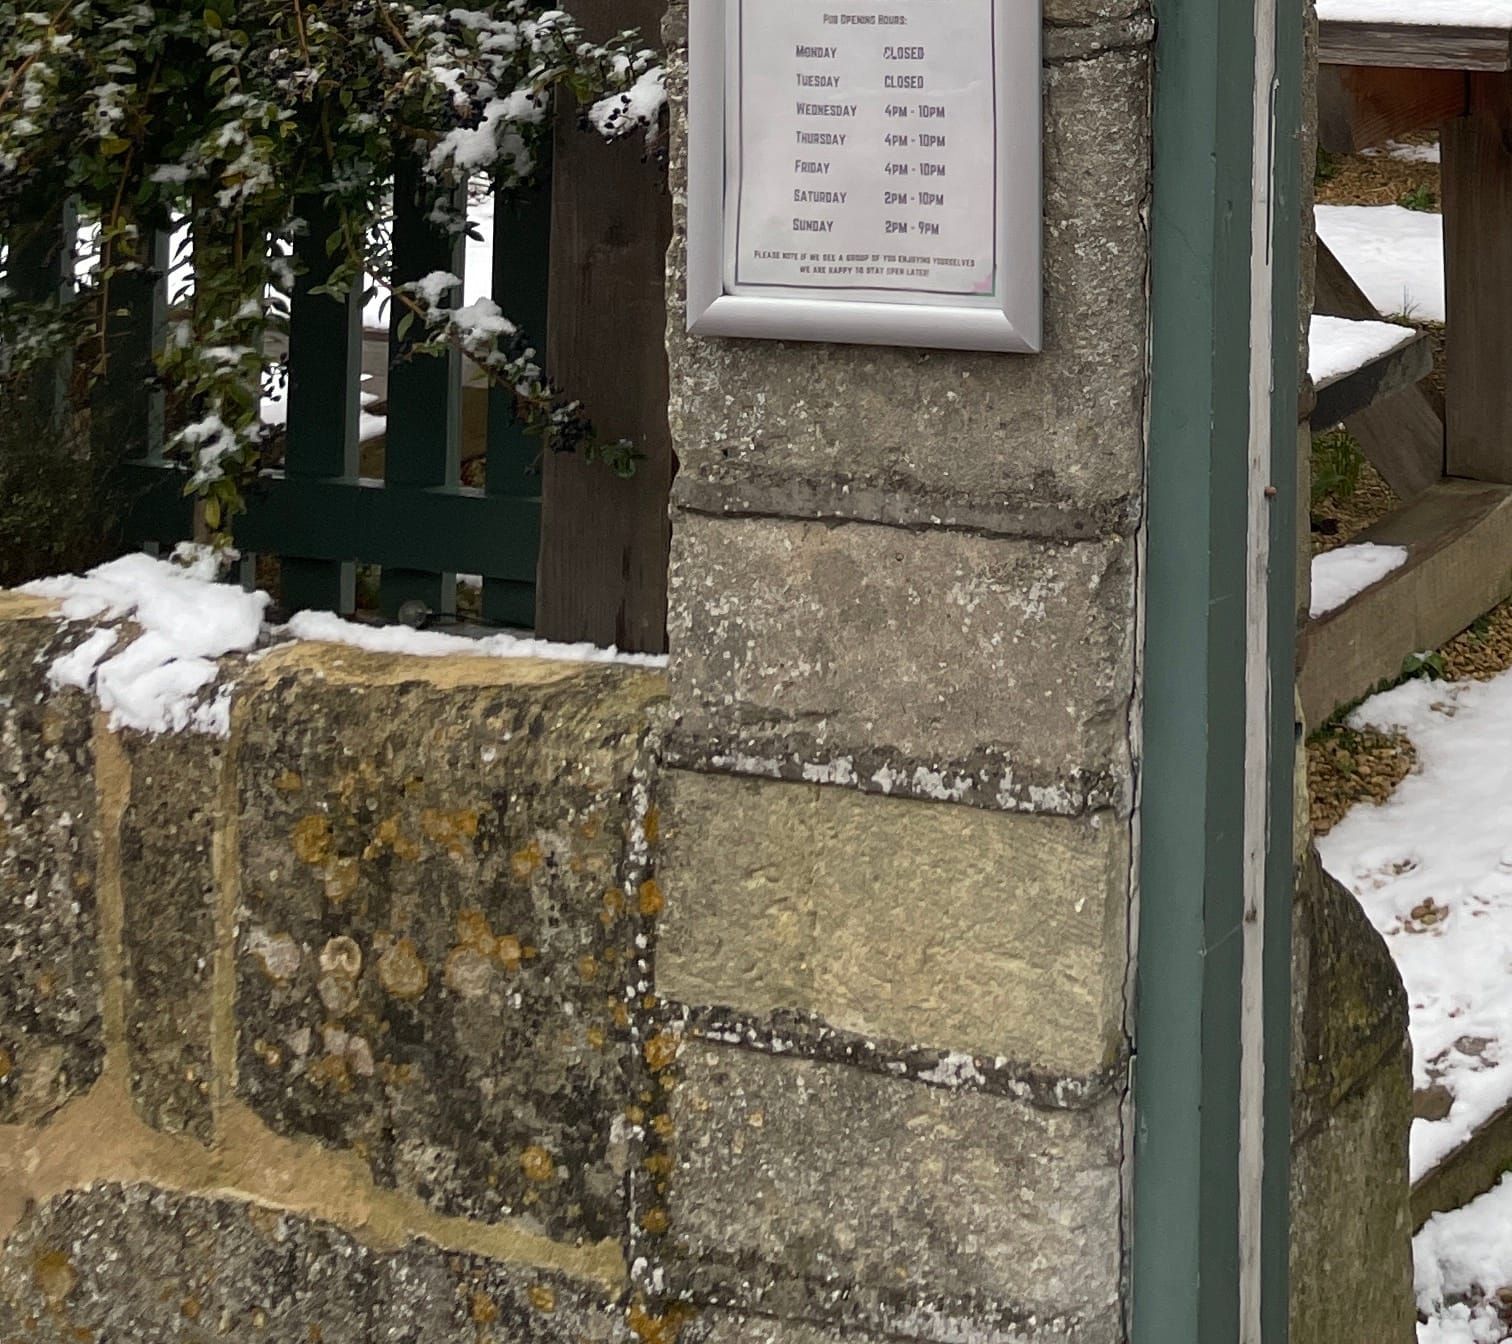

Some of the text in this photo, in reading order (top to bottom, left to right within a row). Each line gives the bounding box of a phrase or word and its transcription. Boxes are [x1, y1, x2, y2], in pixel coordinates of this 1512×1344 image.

[795, 45, 925, 60] MONDAY CLOSED
[796, 73, 924, 89] TUESDAY CLOSED
[796, 101, 857, 117] WEDNESDAY
[884, 104, 908, 118] 4PM
[918, 105, 946, 119] 10PM
[796, 130, 847, 146] THURSDAY
[884, 133, 908, 147] 4PM
[918, 134, 946, 148] 10PM
[794, 159, 831, 174] FRIDAY
[884, 163, 908, 176] 4PM
[919, 163, 946, 177] 10PM
[793, 188, 848, 204] SATURDAY
[884, 191, 908, 205] 2PM
[918, 191, 945, 206] 10PM
[792, 218, 834, 233] SUNDAY
[885, 220, 908, 234] 2PM
[918, 221, 940, 235] 9PM
